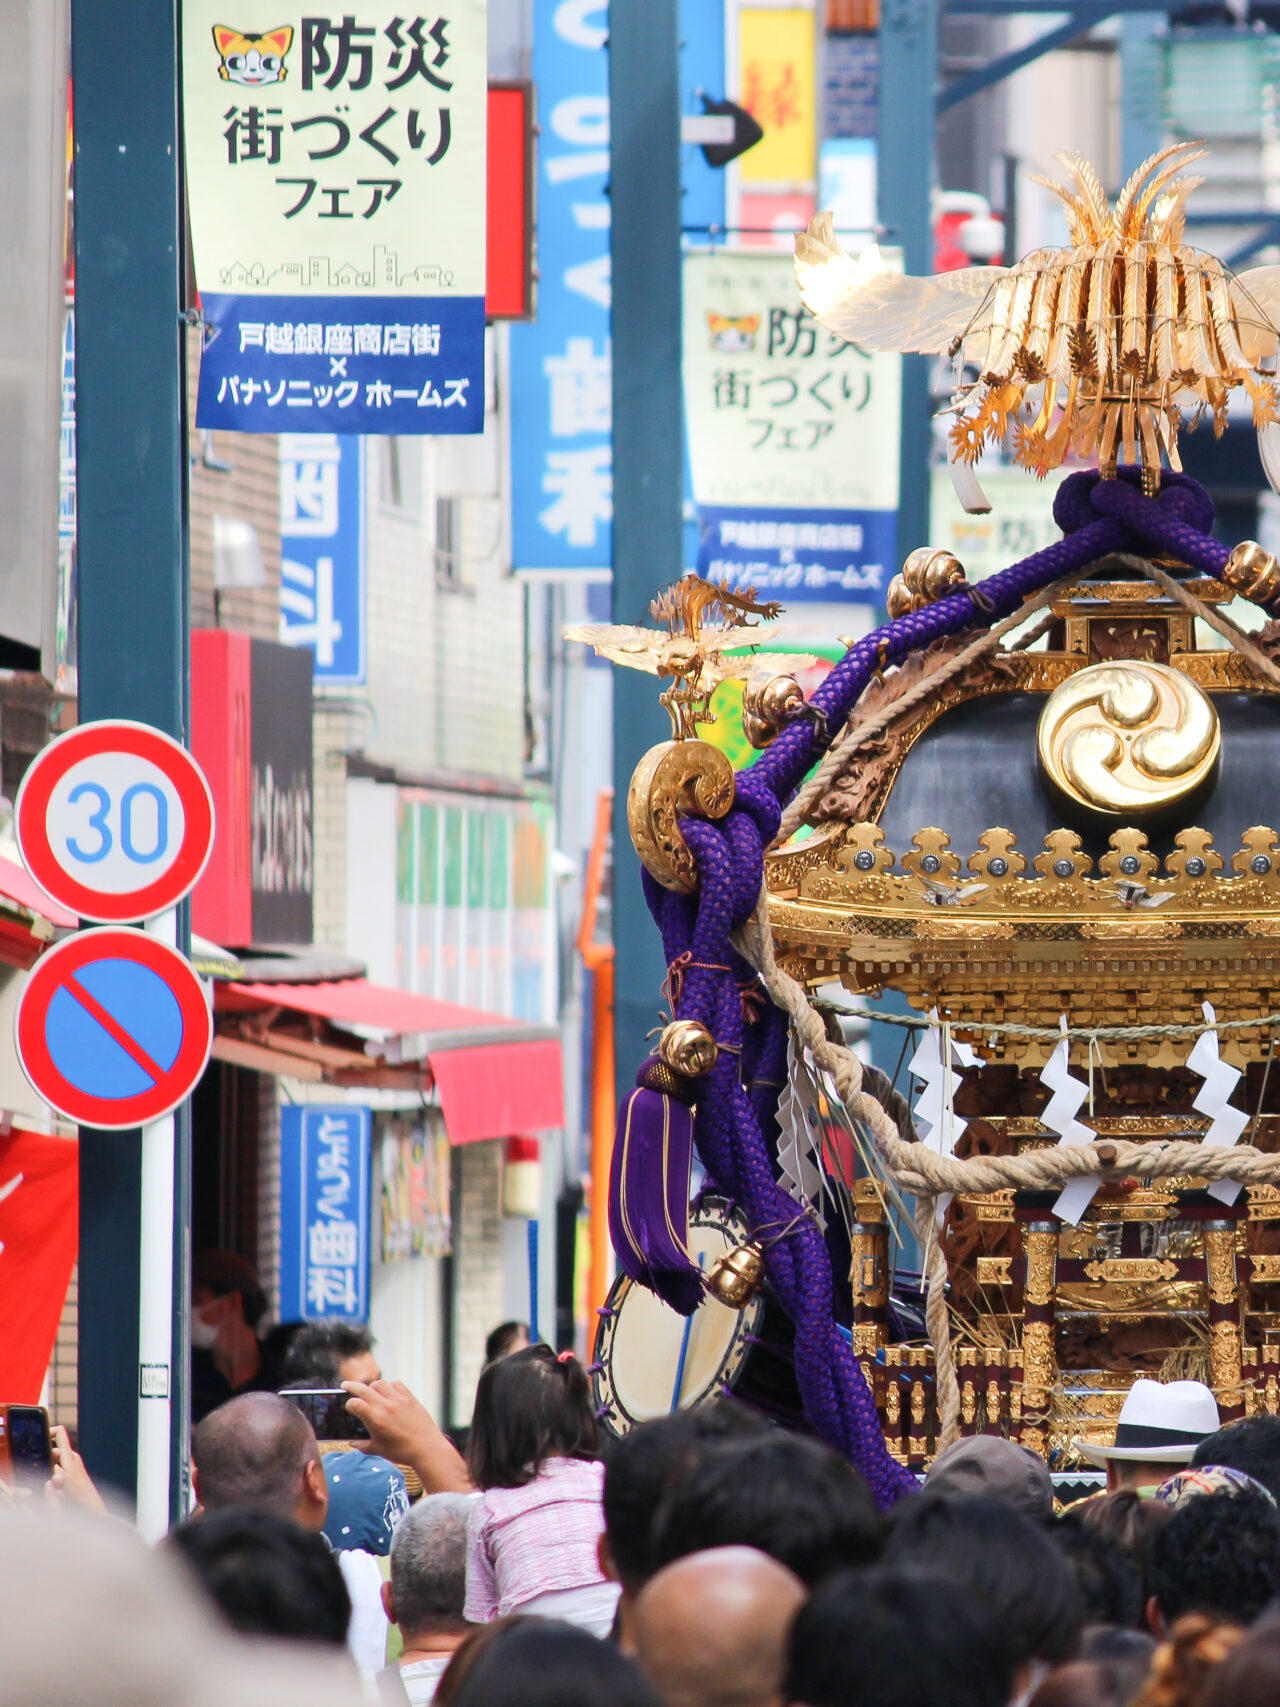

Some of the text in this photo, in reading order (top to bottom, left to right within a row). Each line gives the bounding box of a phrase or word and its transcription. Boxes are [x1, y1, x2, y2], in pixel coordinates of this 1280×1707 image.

[301, 17, 454, 91] 防災
[223, 105, 452, 166] 街づくり
[275, 178, 402, 219] フェア
[238, 322, 441, 356] 戸越銀座商店街
[217, 375, 470, 408] パナソニック ホームズ
[712, 369, 873, 413] 街づくり
[746, 419, 835, 450] フェア
[65, 782, 168, 864] 30
